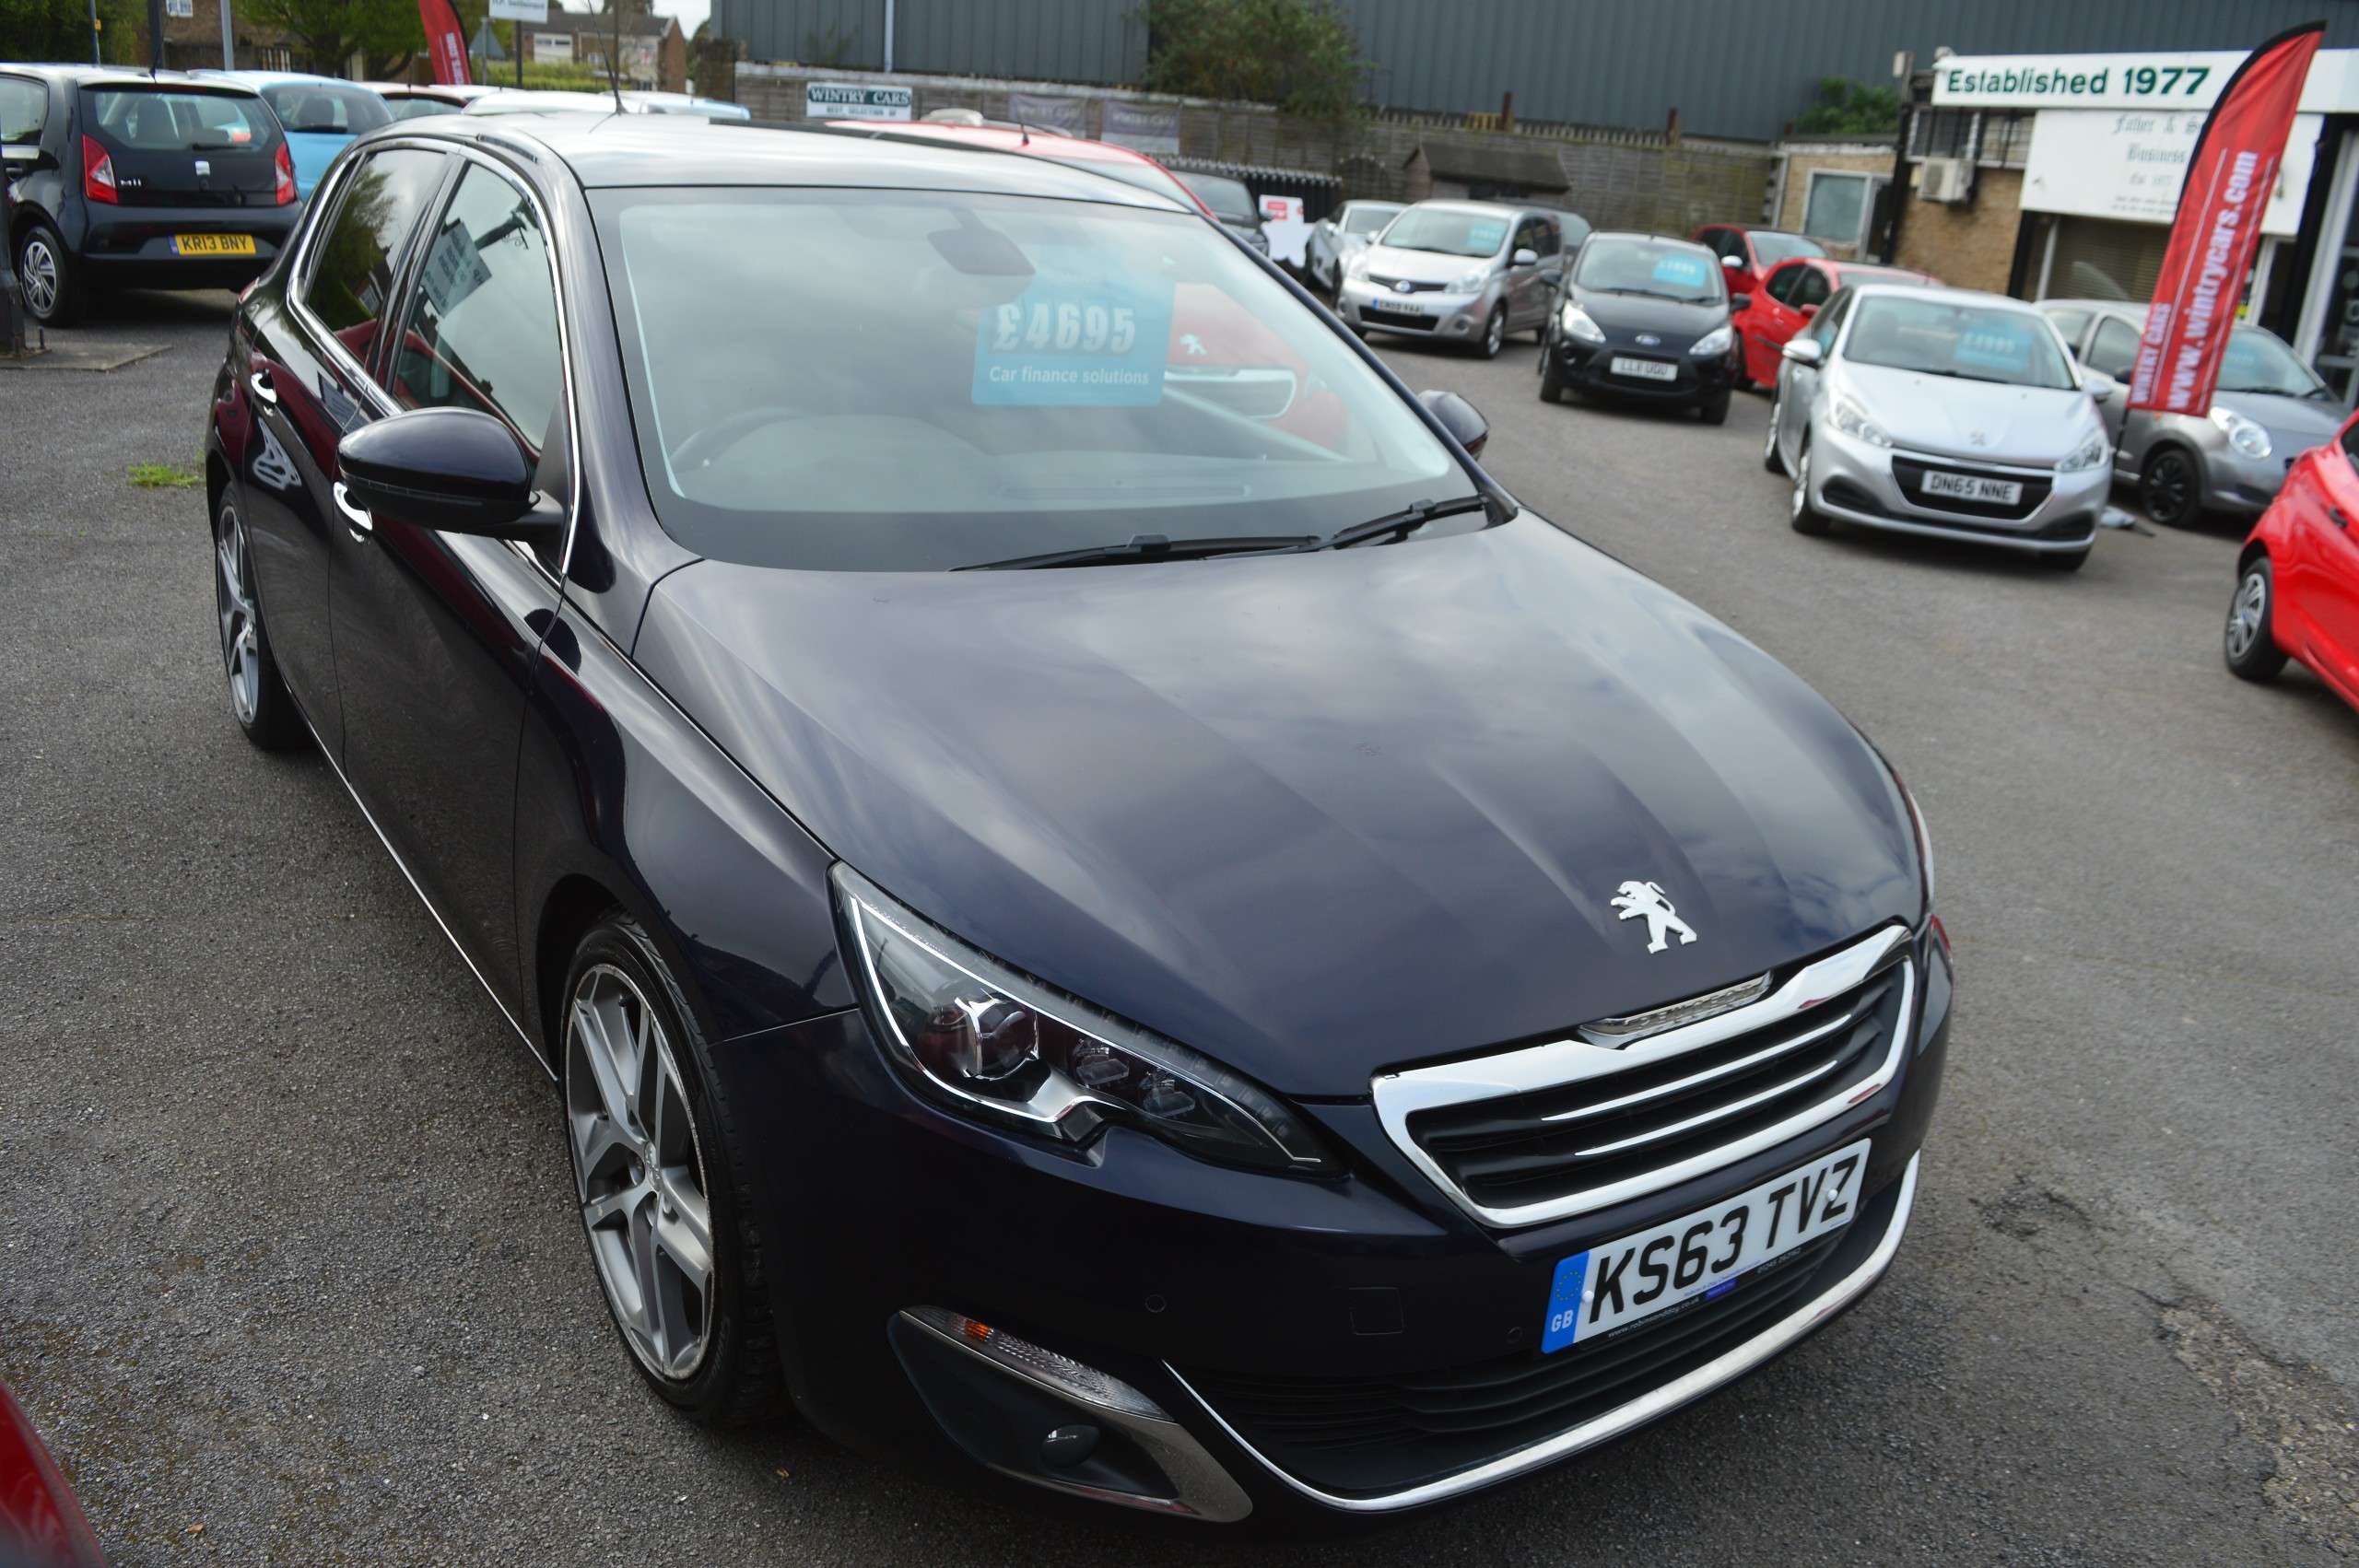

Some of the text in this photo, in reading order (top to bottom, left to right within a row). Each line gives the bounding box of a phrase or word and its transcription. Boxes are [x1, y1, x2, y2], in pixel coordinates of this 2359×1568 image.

[1947, 66, 2211, 95] Established 1977
[811, 88, 910, 105] WINTRY CARS
[182, 235, 248, 251] KR13 BNY
[2166, 151, 2258, 410] www.wintrycars.com
[992, 302, 1135, 354] £4695
[2130, 301, 2172, 404] WINTRY CARS
[990, 366, 1150, 385] Car finance solutions
[1931, 474, 2013, 499] DN65 NNE
[1589, 1153, 1860, 1324] KS63 TVZ
[1551, 1309, 1574, 1333] GB
